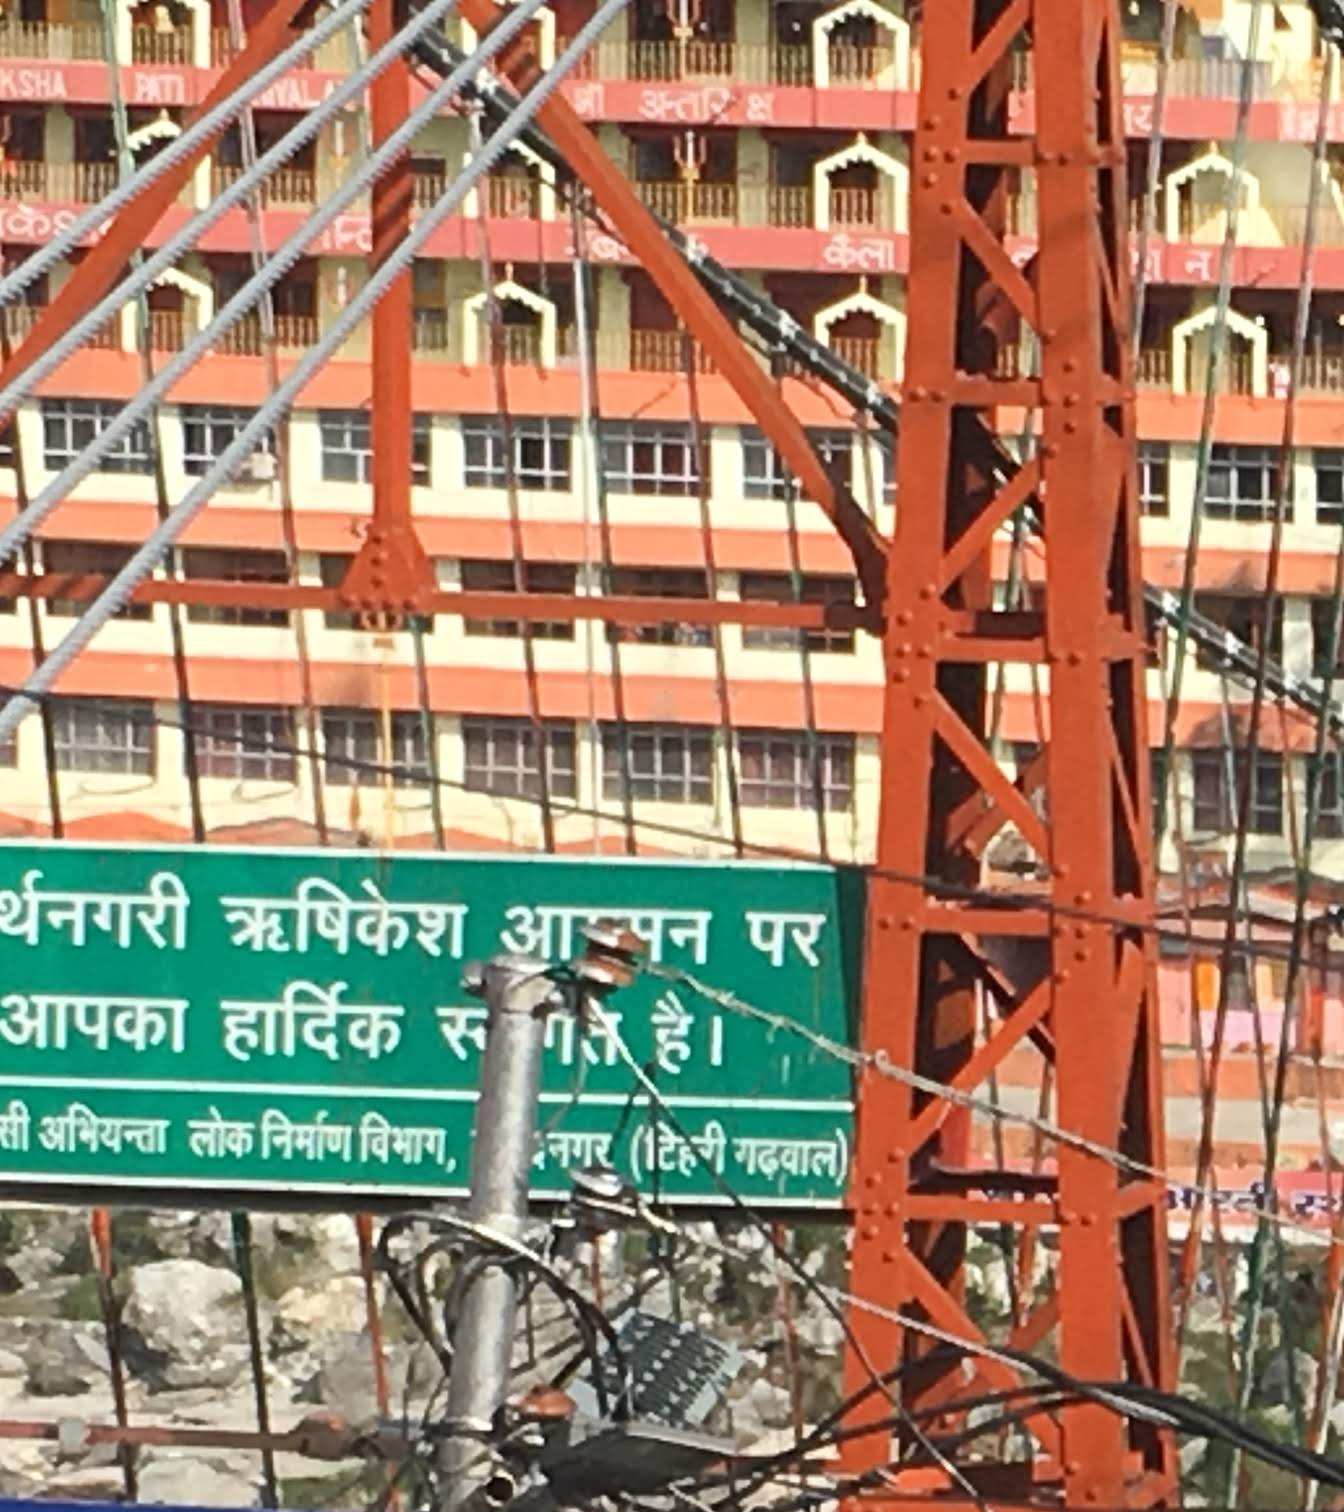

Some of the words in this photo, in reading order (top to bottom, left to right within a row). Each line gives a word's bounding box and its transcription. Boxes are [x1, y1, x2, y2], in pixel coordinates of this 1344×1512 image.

[219, 877, 468, 959] ऋषिकेश
[501, 905, 712, 965] आमन
[745, 911, 827, 967] पर
[0, 994, 190, 1053] आपका
[219, 981, 404, 1060] हार्दिक
[38, 1102, 170, 1154] अभियन्ता
[188, 1105, 256, 1159] लोक
[261, 1108, 352, 1162] निर्माण
[359, 1110, 458, 1173] विभाग,
